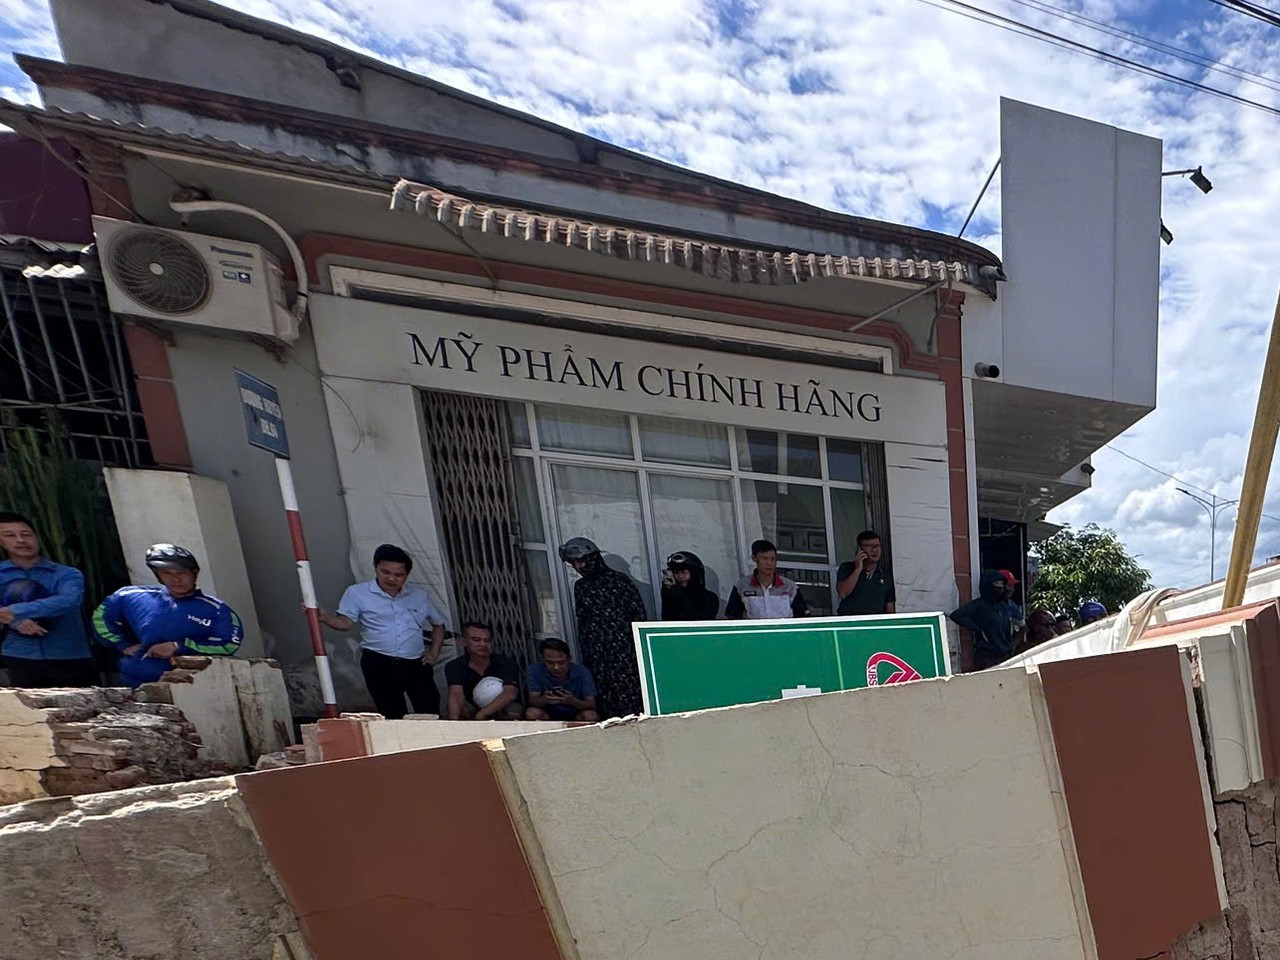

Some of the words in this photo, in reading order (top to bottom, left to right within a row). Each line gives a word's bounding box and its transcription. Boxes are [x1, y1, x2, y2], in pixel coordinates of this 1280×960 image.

[404, 330, 484, 373] MỸ
[496, 343, 628, 392] PHẨM
[637, 363, 766, 409] CHÍNH
[774, 379, 883, 423] HÃNG
